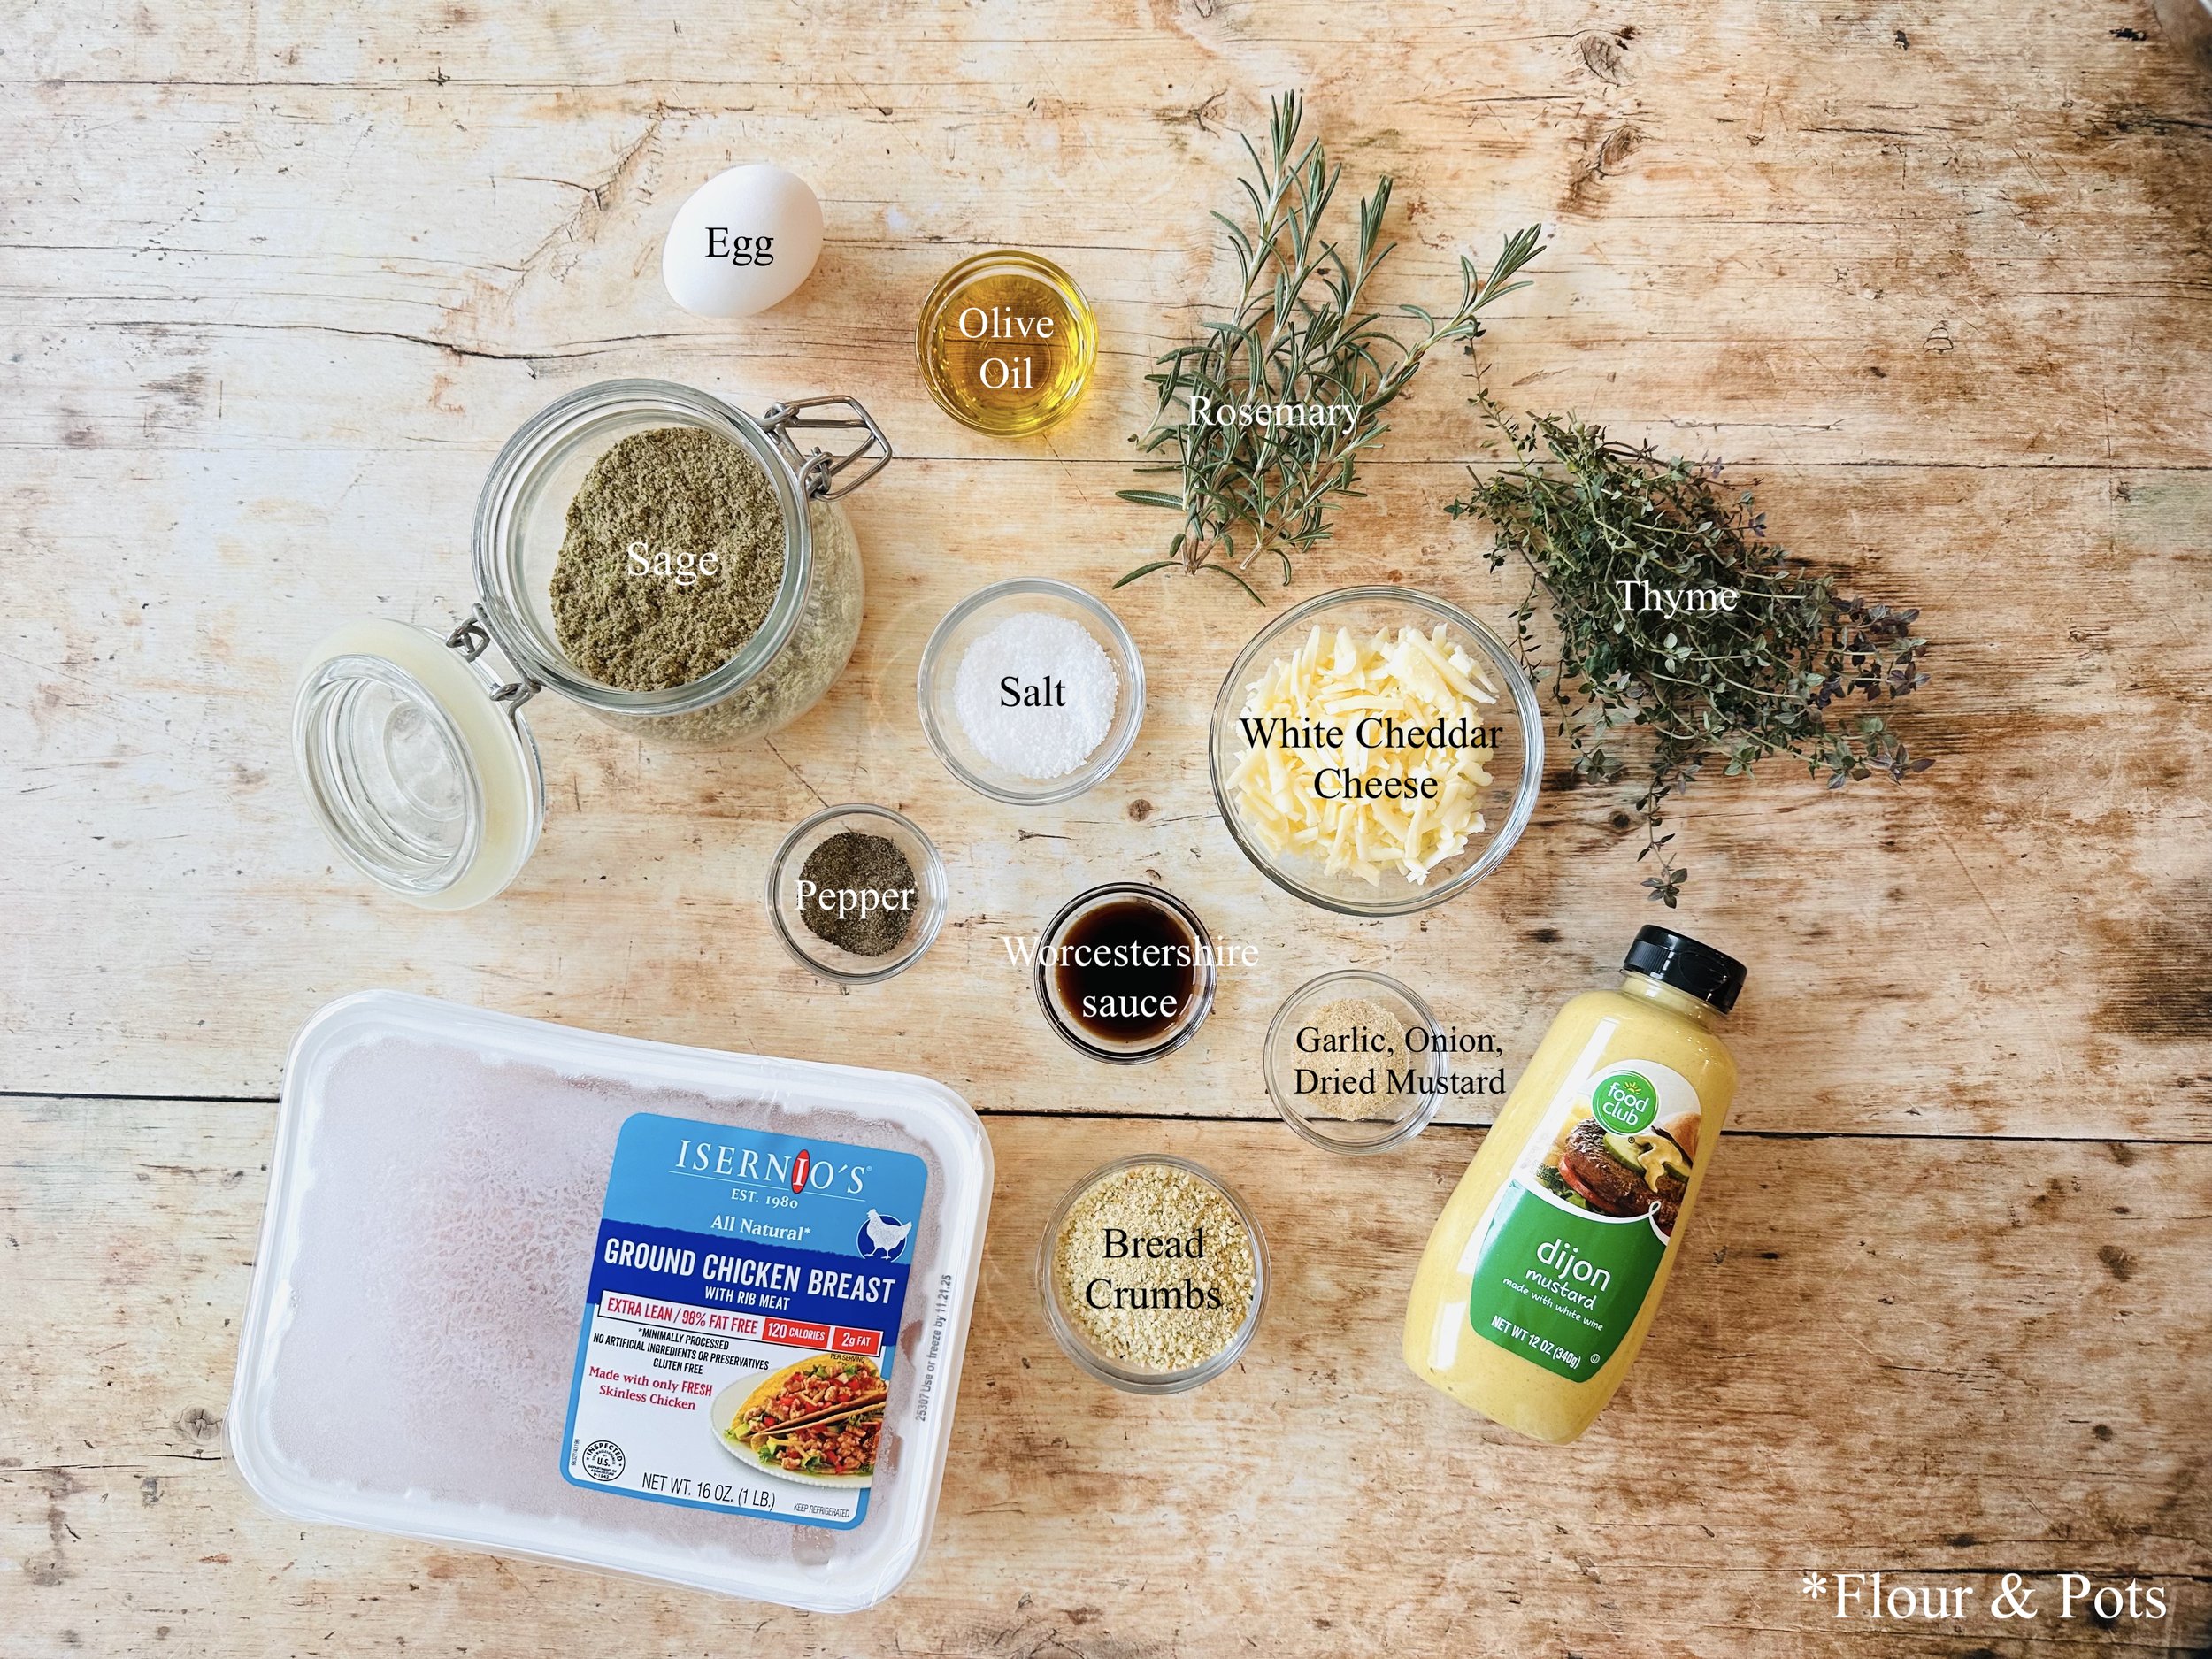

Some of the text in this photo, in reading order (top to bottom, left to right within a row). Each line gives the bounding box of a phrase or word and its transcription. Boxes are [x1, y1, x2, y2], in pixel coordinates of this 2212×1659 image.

[1608, 1082, 1649, 1112] food
[1602, 1102, 1639, 1125] club
[731, 1188, 798, 1209] EST. 1980
[710, 1215, 735, 1231] All
[603, 1238, 896, 1304] GROUND CHICKEN BREAST
[1536, 1238, 1611, 1292] dijon
[704, 1286, 791, 1310] WITH RIB MEAT
[1525, 1269, 1597, 1311] mustard
[607, 1297, 758, 1334] EXTRA LEAN / 98% FAT FREE
[1502, 1278, 1604, 1332] made with white wine
[685, 1333, 729, 1350] PROCESSED
[768, 1323, 826, 1341] 120 CALORIES
[841, 1333, 871, 1347] 2g FAT
[1491, 1315, 1582, 1370] NET WT 12 OZ (340g)
[593, 1333, 770, 1371] NO ARTIFICIAL INGREDIENTS OR PRESERVATIVES
[841, 1355, 865, 1363] SERVING
[915, 1274, 952, 1422] 25307 Use or freeze by 11.21.25
[653, 1357, 703, 1374] GLUTEN FREE
[589, 1366, 713, 1397] Made with only FRESH
[599, 1385, 695, 1411] Skinless Chicken
[586, 1442, 623, 1462] INSPECTED
[596, 1457, 611, 1467] U.S.
[642, 1471, 776, 1512] NET WT. 16 OZ. (1 LB.)
[794, 1503, 850, 1518] KEEP REFRIGERATED
